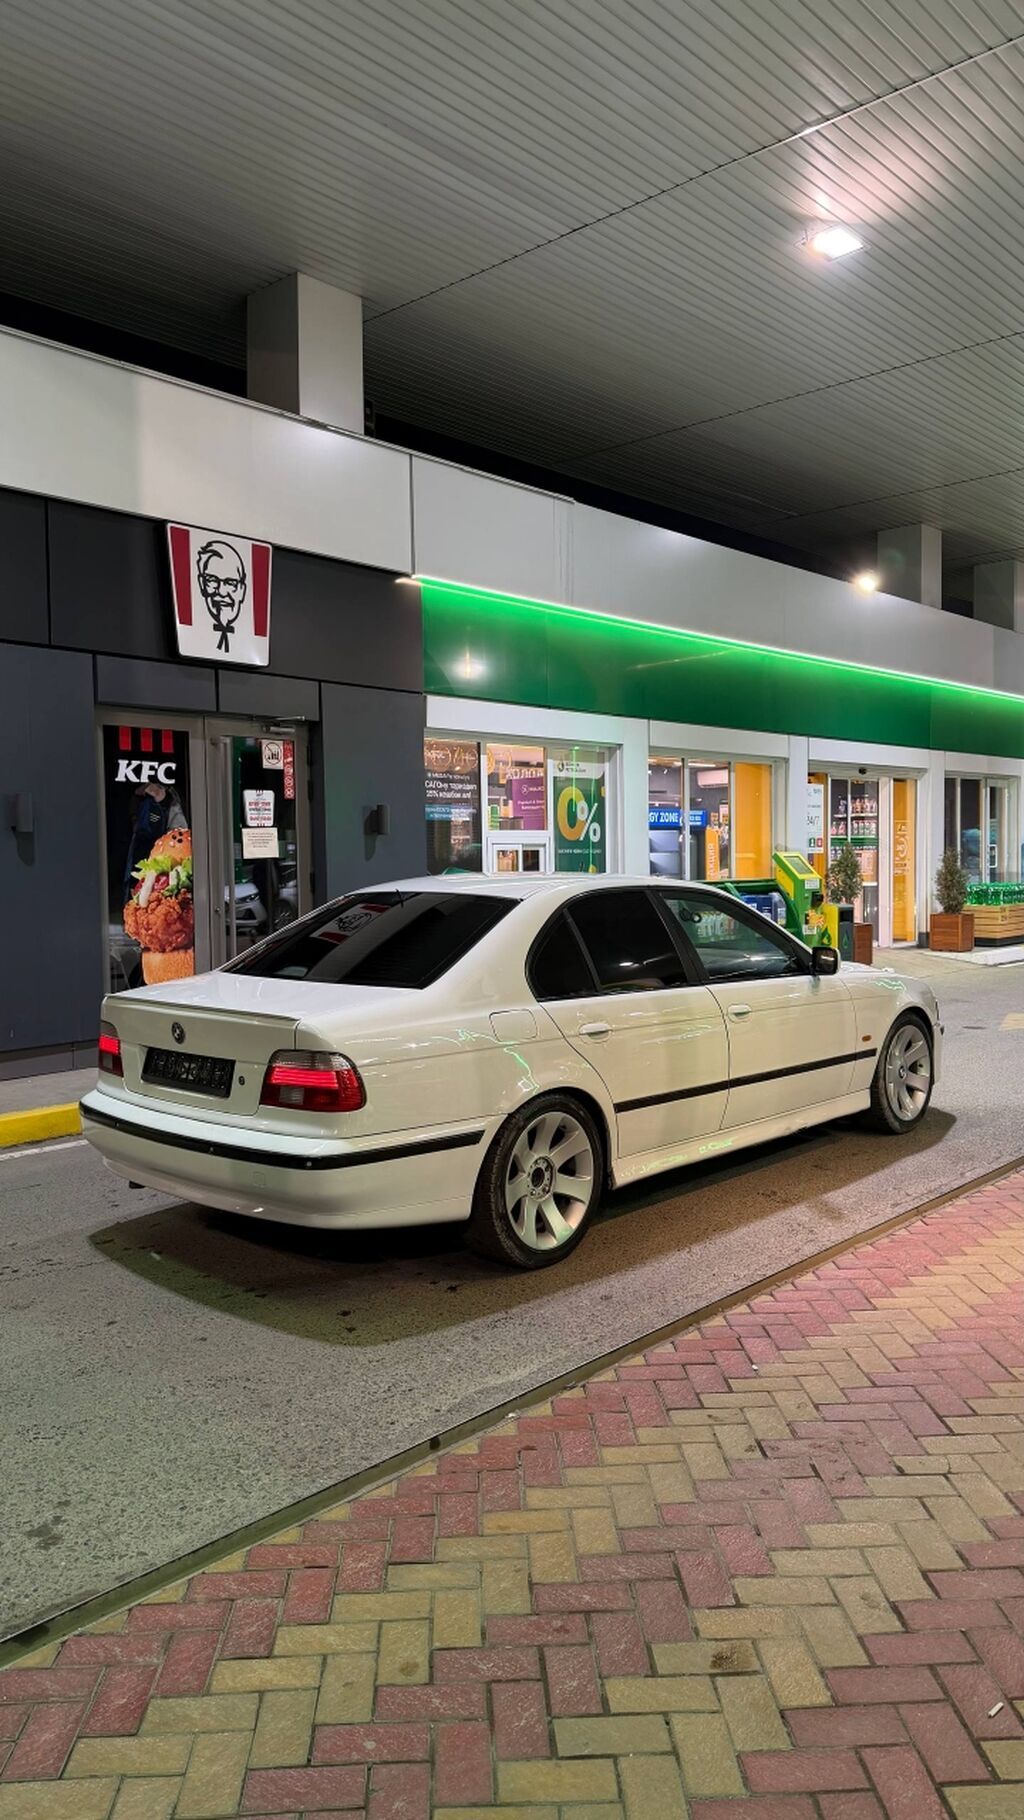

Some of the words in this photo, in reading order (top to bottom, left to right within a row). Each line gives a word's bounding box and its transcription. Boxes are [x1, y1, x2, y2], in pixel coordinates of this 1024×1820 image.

[115, 759, 177, 784] KFC
[557, 786, 601, 843] 0%
[660, 812, 679, 823] ZONE
